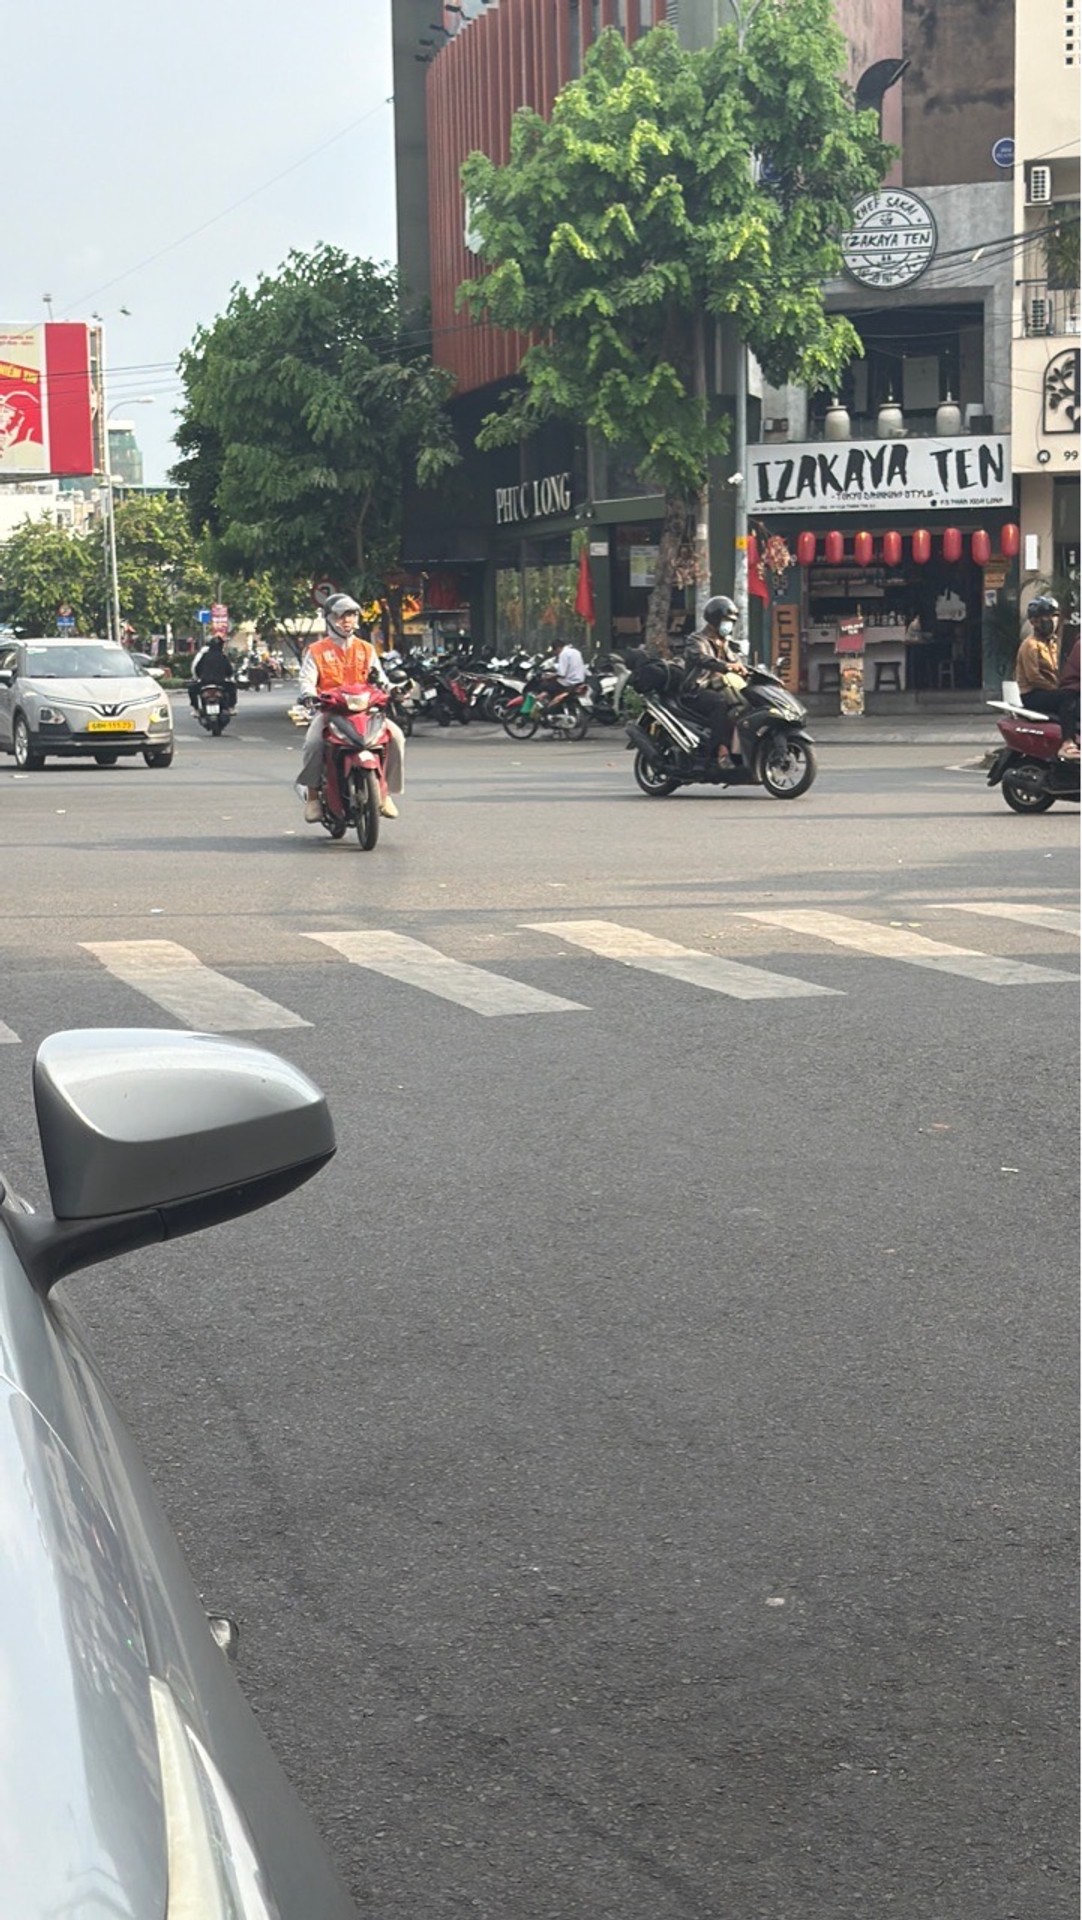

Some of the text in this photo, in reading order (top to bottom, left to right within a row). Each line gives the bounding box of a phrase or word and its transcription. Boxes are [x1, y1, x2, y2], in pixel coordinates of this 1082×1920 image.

[856, 196, 918, 220] CHEF SAKAI
[903, 231, 930, 246] TEN
[753, 443, 1004, 503] IZAKAYA TEN
[533, 472, 572, 516] LONG
